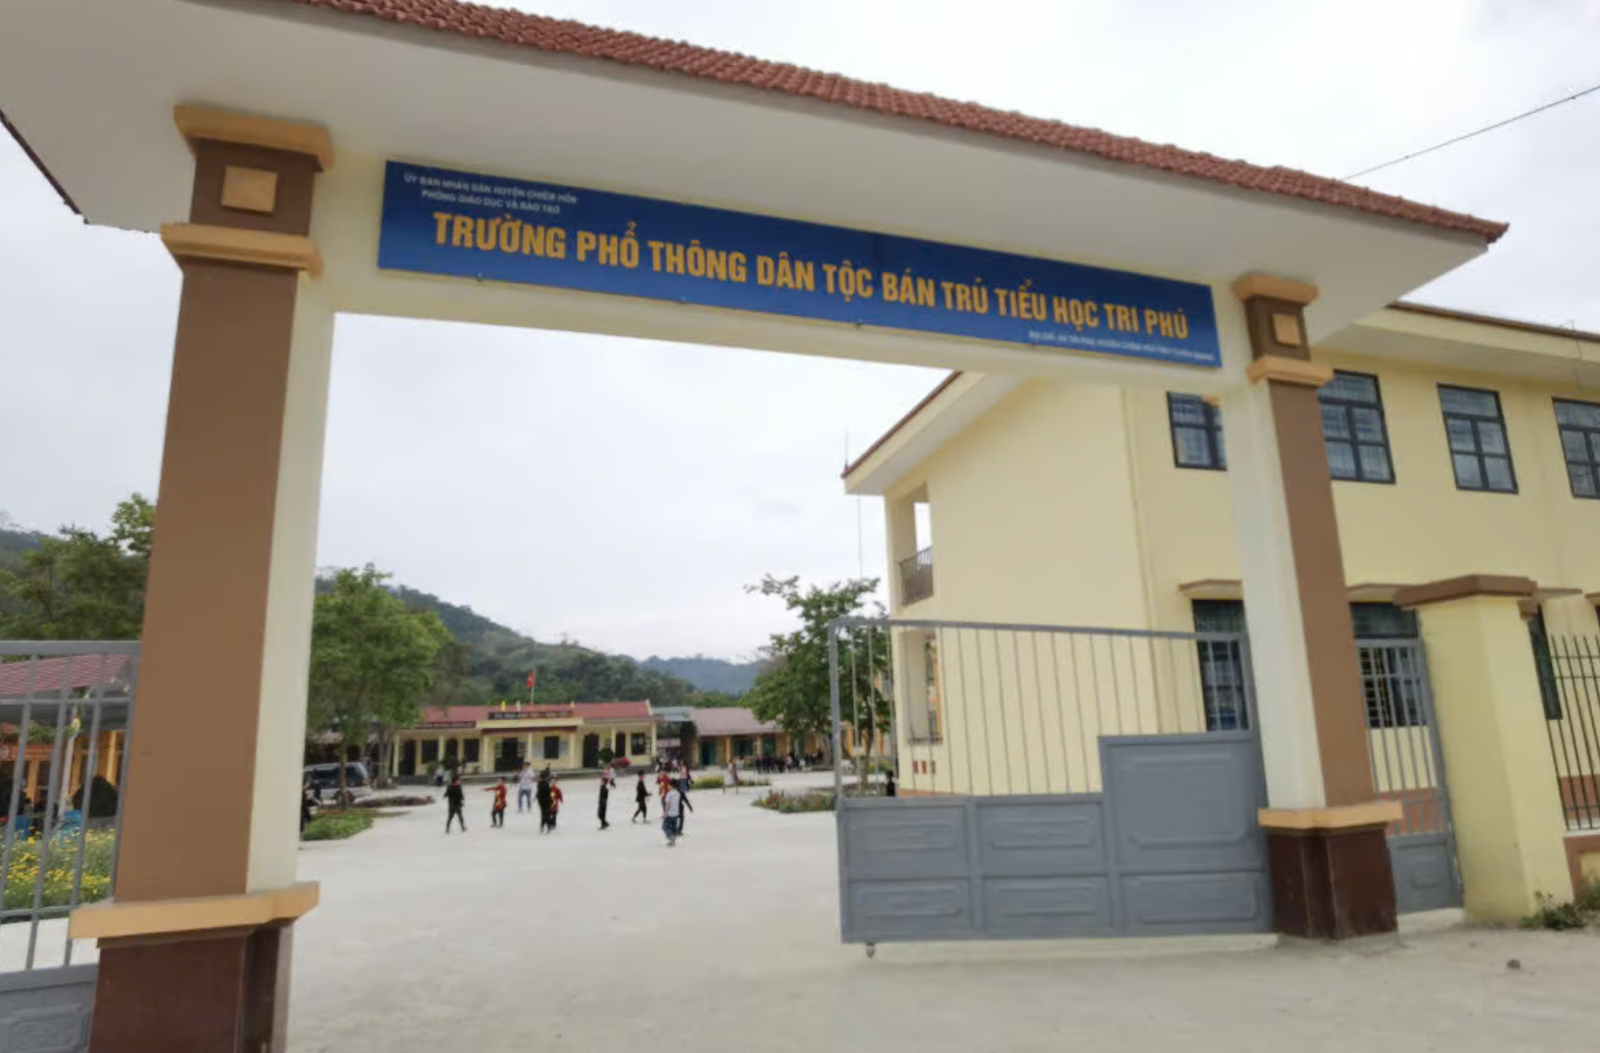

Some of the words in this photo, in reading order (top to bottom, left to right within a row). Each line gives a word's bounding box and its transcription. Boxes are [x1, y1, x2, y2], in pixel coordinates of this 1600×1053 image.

[420, 175, 440, 187] BAN
[433, 211, 566, 260] TRƯỜNG
[576, 220, 640, 269] PHỔ
[648, 239, 748, 283] THÔNG
[756, 251, 815, 292] DÂN
[822, 259, 873, 302] TỘC
[882, 267, 935, 307] BÁN
[941, 278, 988, 315] TRÚ
[994, 278, 1047, 321] TIỂU
[1053, 296, 1099, 332] HỌC
[1104, 304, 1140, 333] TRI
[1144, 307, 1188, 339] PHÚ
